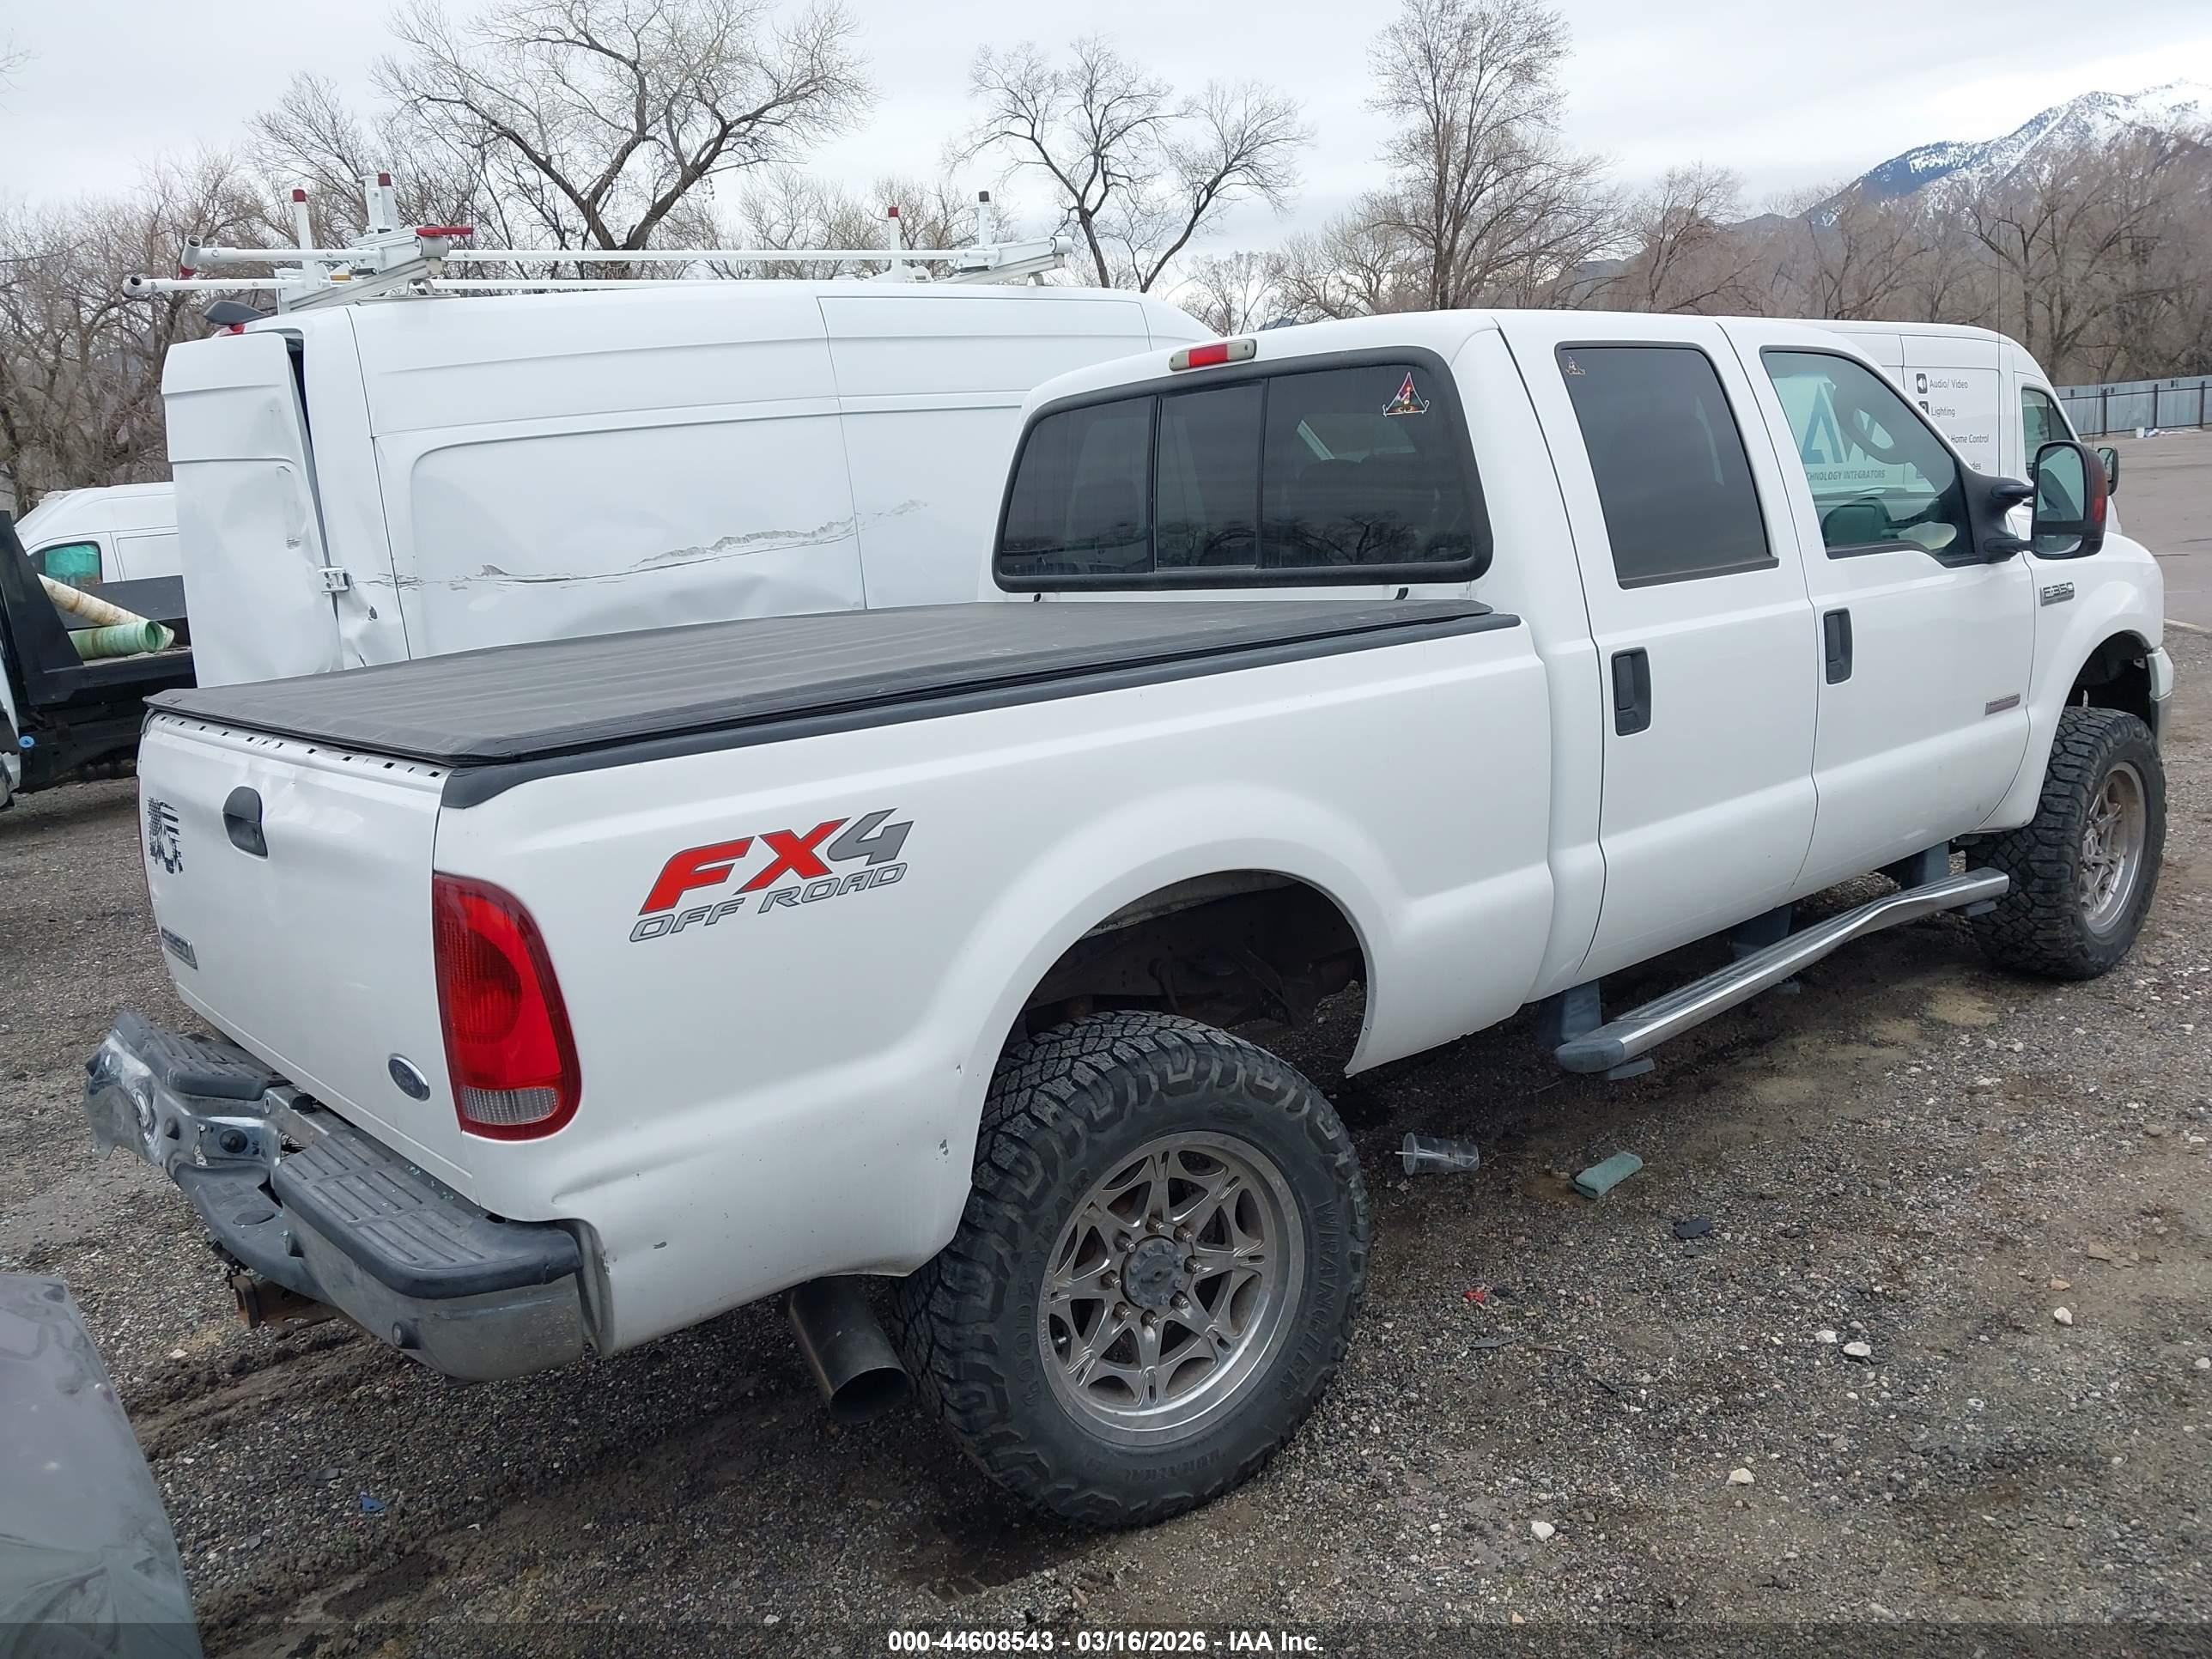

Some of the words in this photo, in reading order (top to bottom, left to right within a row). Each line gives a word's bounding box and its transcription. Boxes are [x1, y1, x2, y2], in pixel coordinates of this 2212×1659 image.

[1951, 379, 1968, 389] Video
[1930, 406, 1955, 417] Lighting
[1951, 434, 1967, 443] Home
[1969, 434, 1989, 443] Control
[1807, 471, 1842, 481] CHNOLOGY
[1843, 469, 1886, 480] INTEGRATORS
[638, 807, 915, 915] FX4
[629, 897, 745, 943] OFF
[757, 862, 908, 914] ROAD
[1279, 1198, 1338, 1401] WRANGLER
